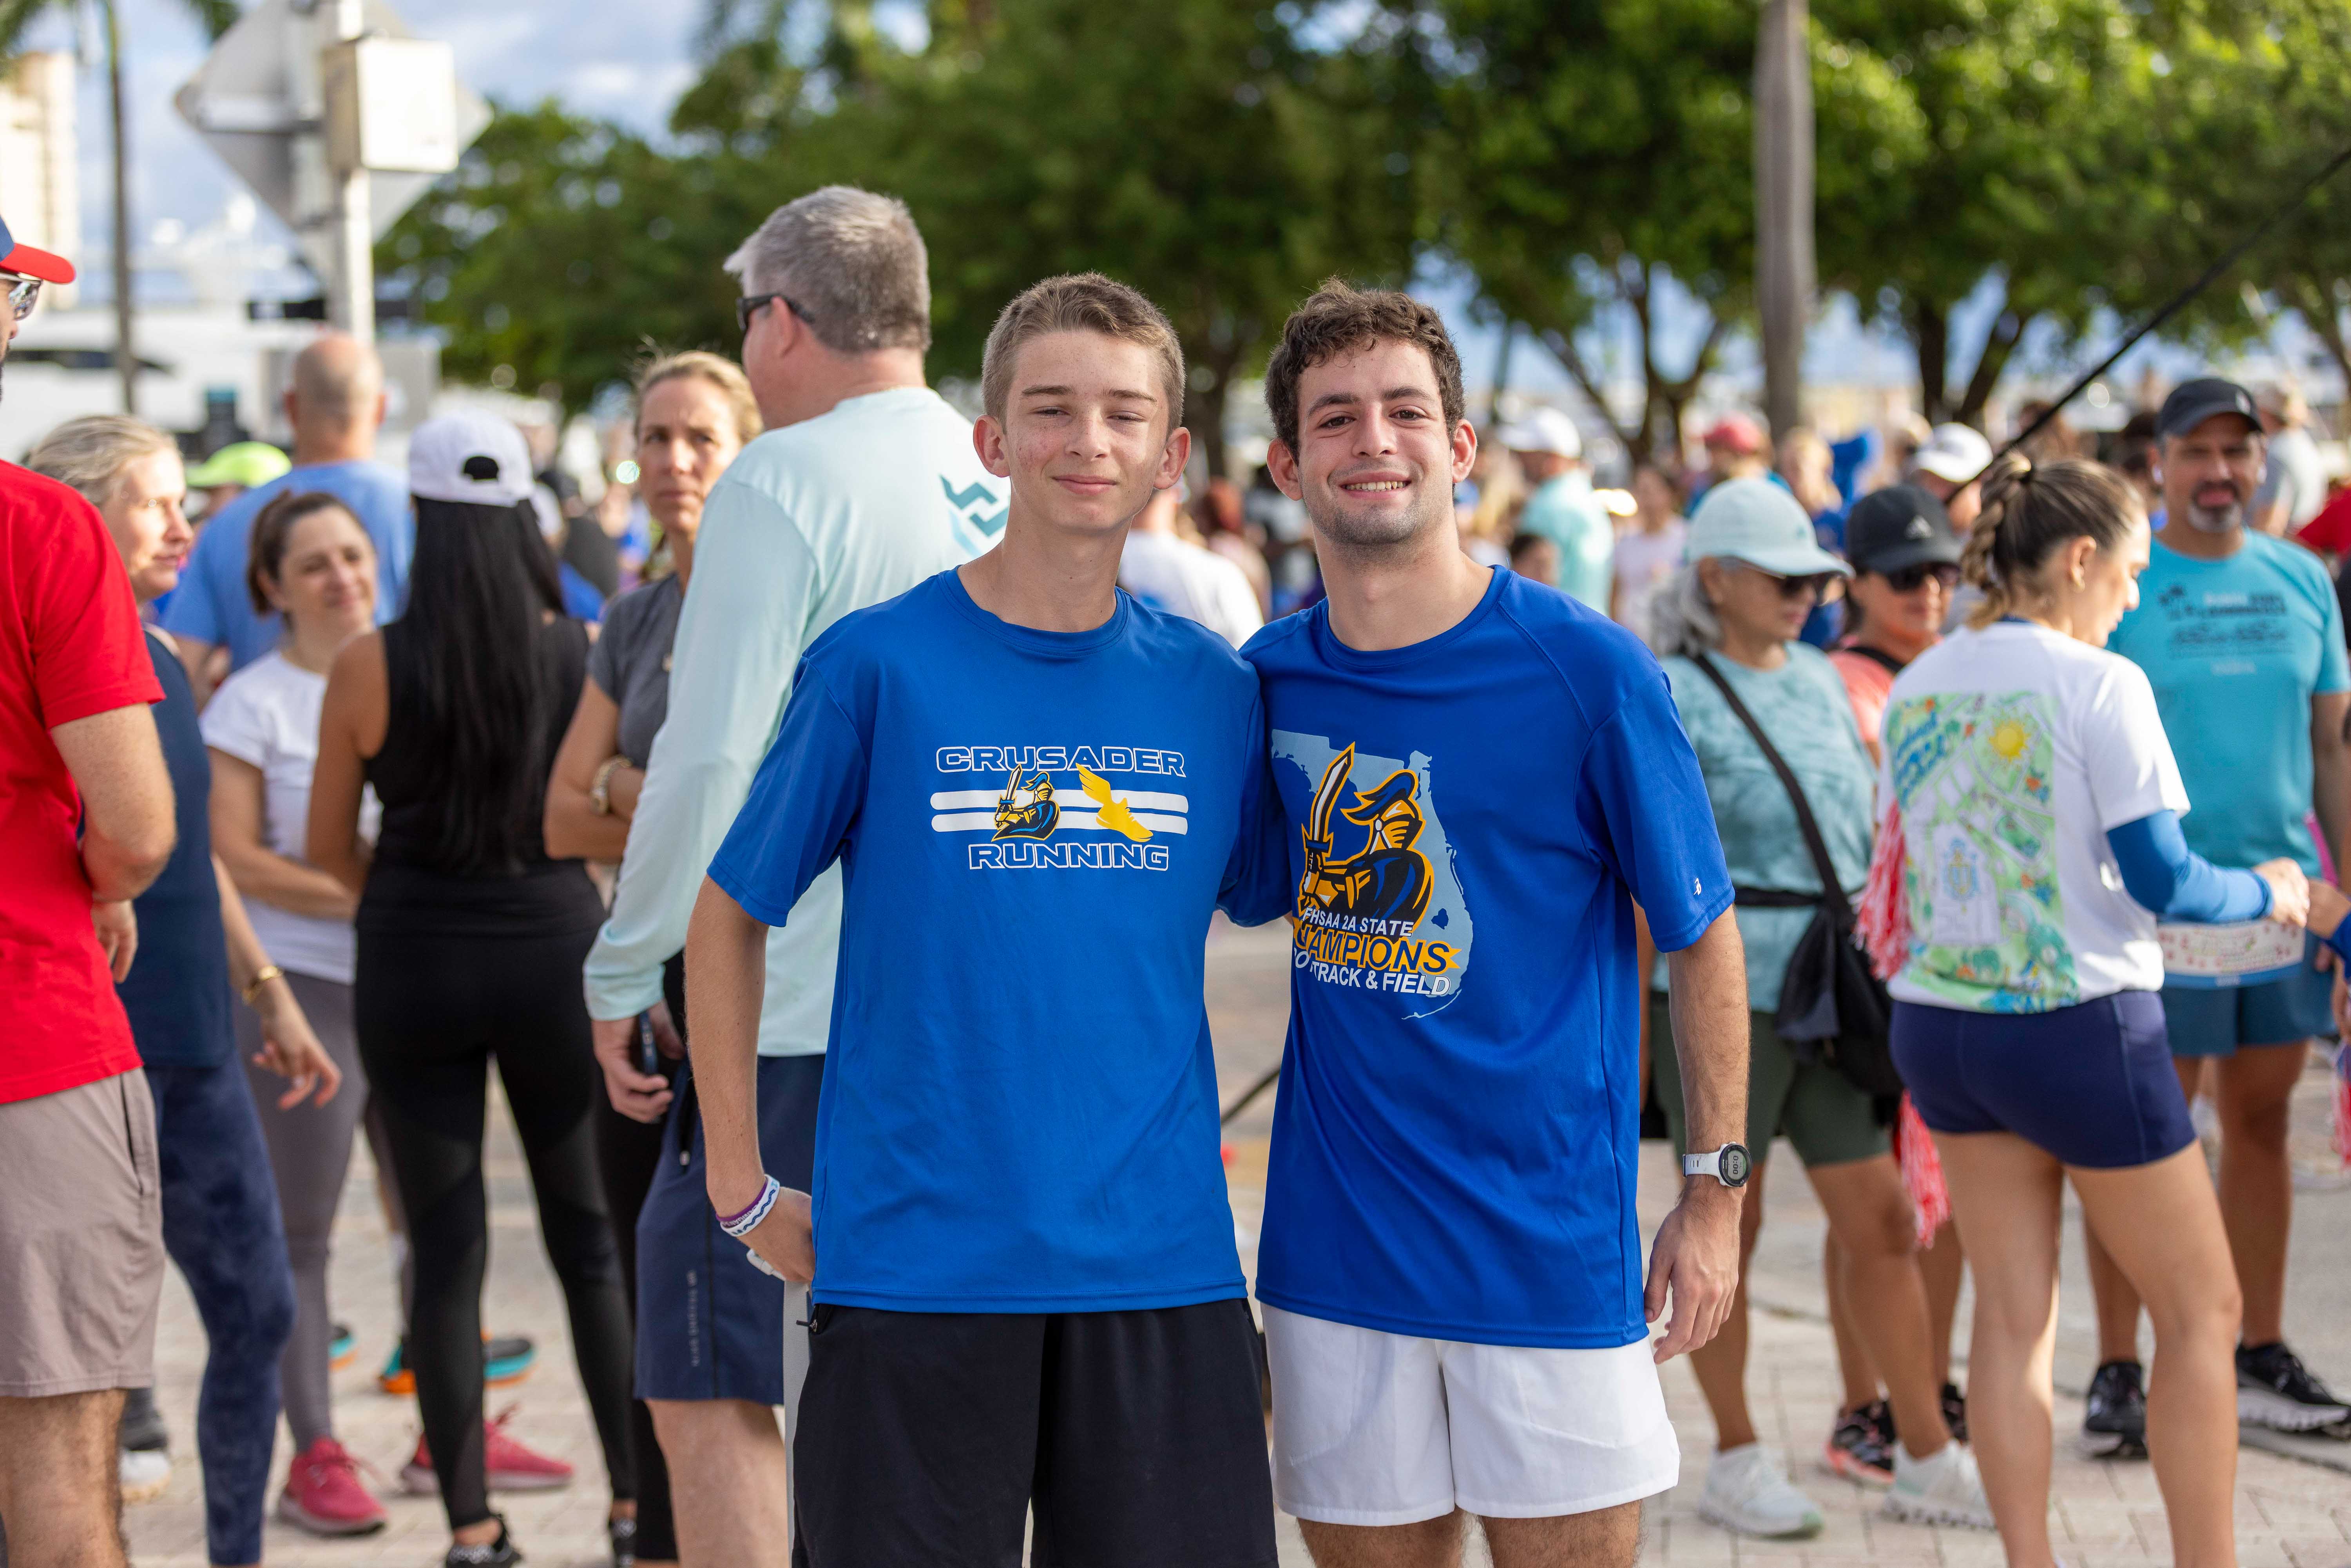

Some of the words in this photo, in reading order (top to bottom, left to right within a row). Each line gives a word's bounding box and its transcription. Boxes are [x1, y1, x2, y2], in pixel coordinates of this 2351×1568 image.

[936, 746, 1186, 777] CRUSADER
[968, 843, 1169, 871] RUNNING
[1302, 907, 1340, 929] FHSAA
[1342, 915, 1356, 931] 2A
[1360, 918, 1414, 937] STATE
[1312, 961, 1362, 988] TRACK
[1365, 970, 1378, 990] &
[1382, 972, 1451, 996] FIELD
